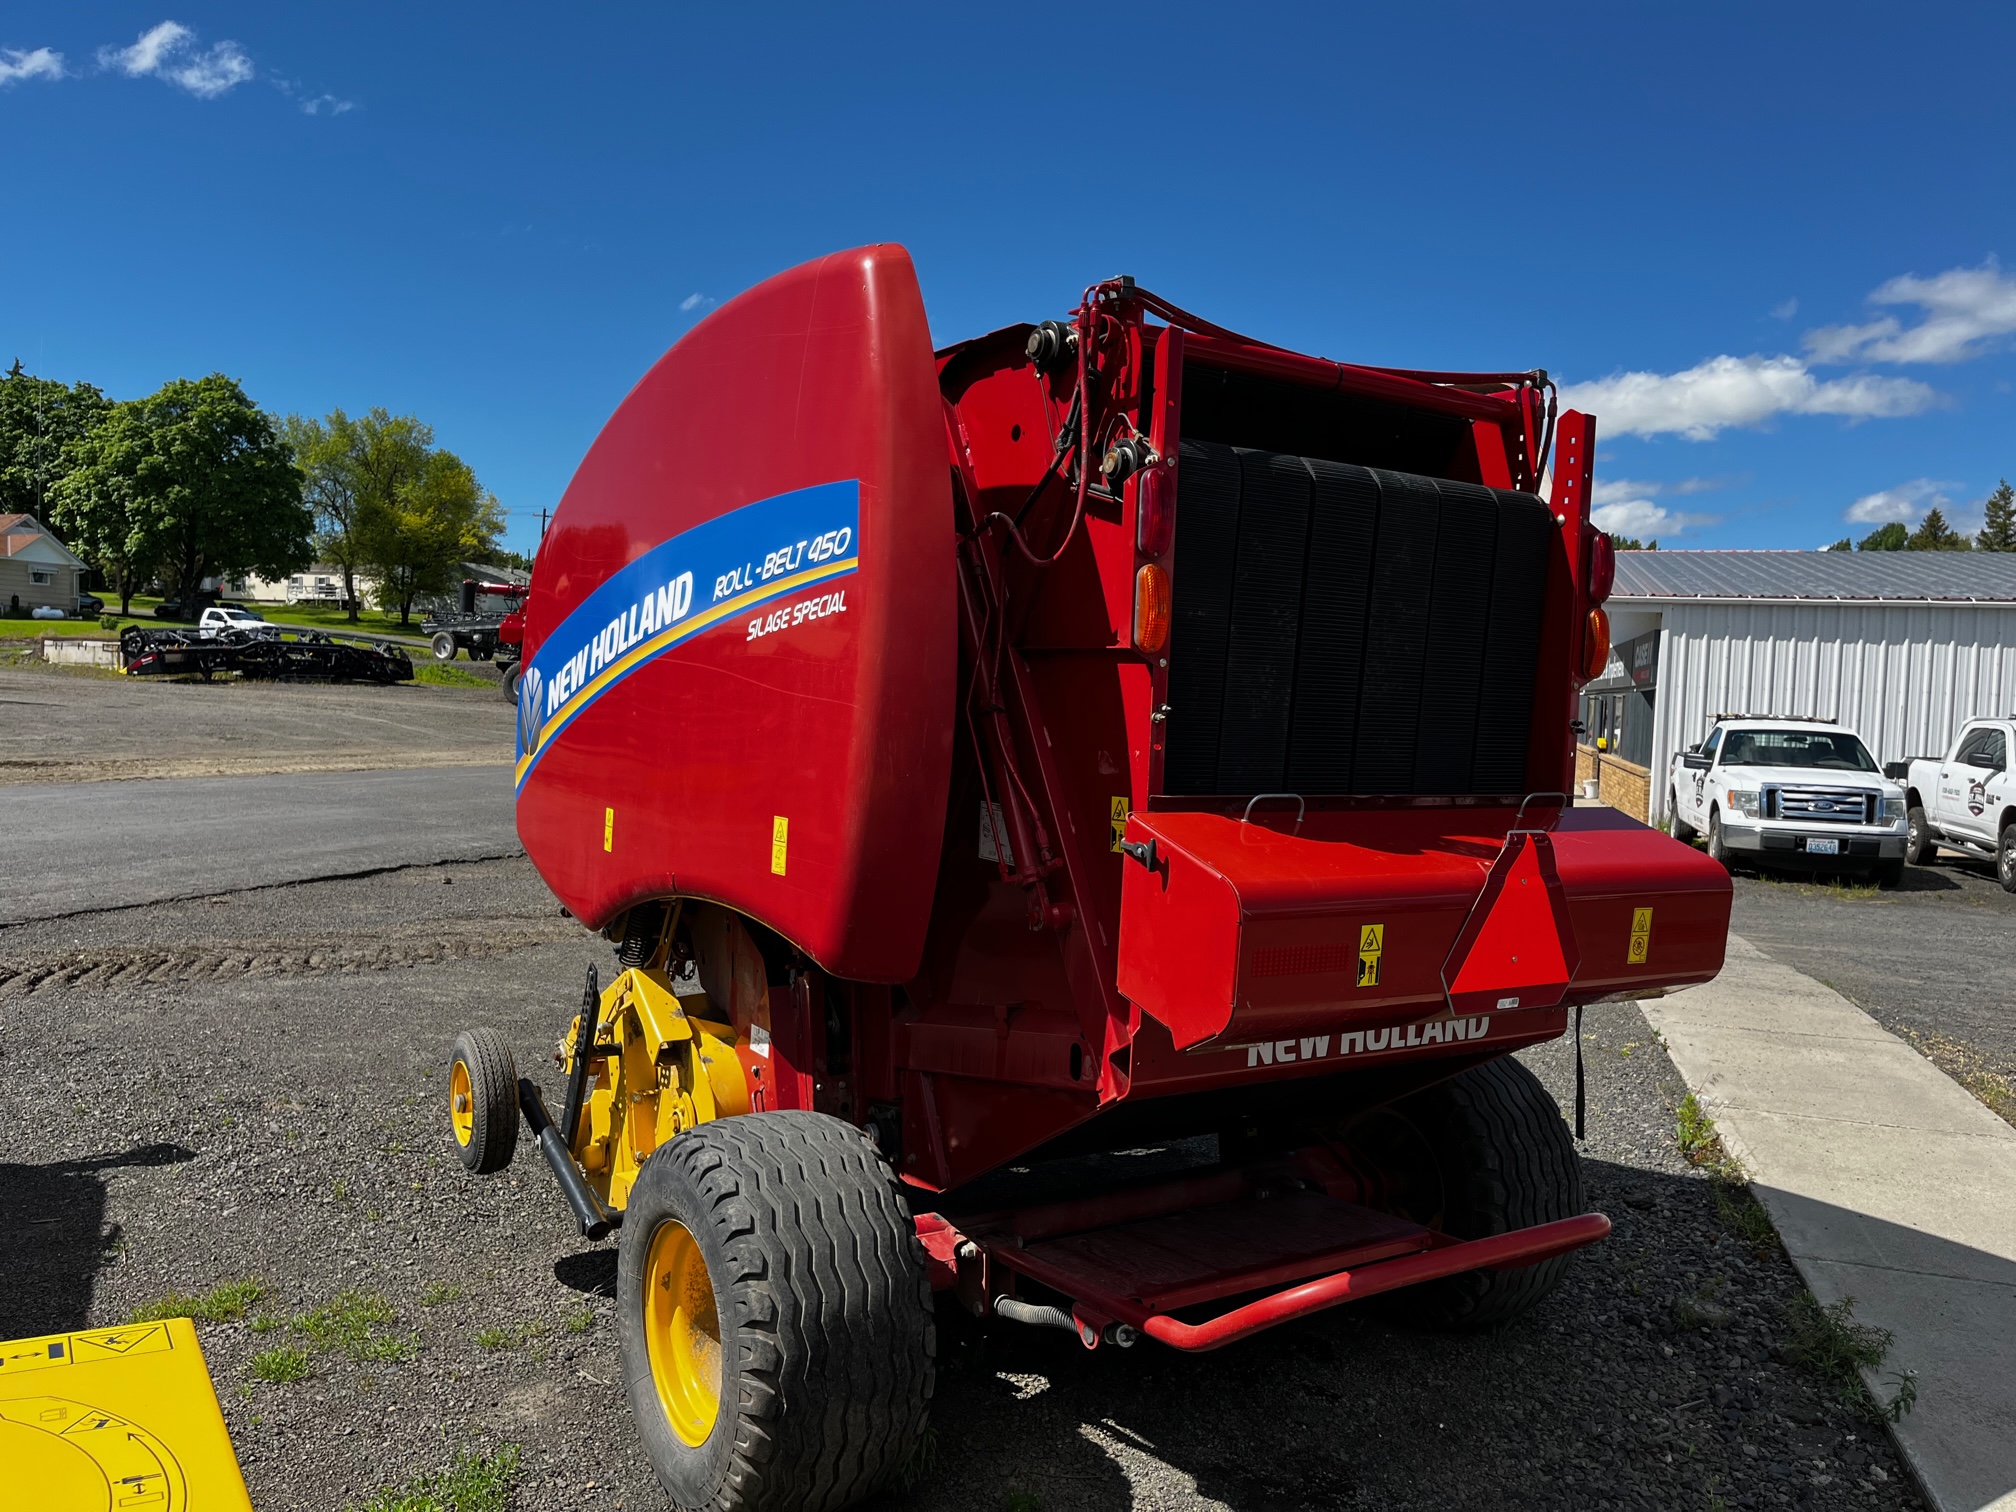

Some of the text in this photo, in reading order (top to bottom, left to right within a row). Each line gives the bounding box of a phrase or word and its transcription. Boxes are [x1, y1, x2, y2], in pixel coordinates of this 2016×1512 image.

[713, 527, 852, 601] ROLL-BELT 450
[547, 571, 693, 717] NEW HOLLAND
[746, 590, 847, 641] SILAGE SPECIAL
[1247, 1016, 1489, 1067] NEW HOLLAND
